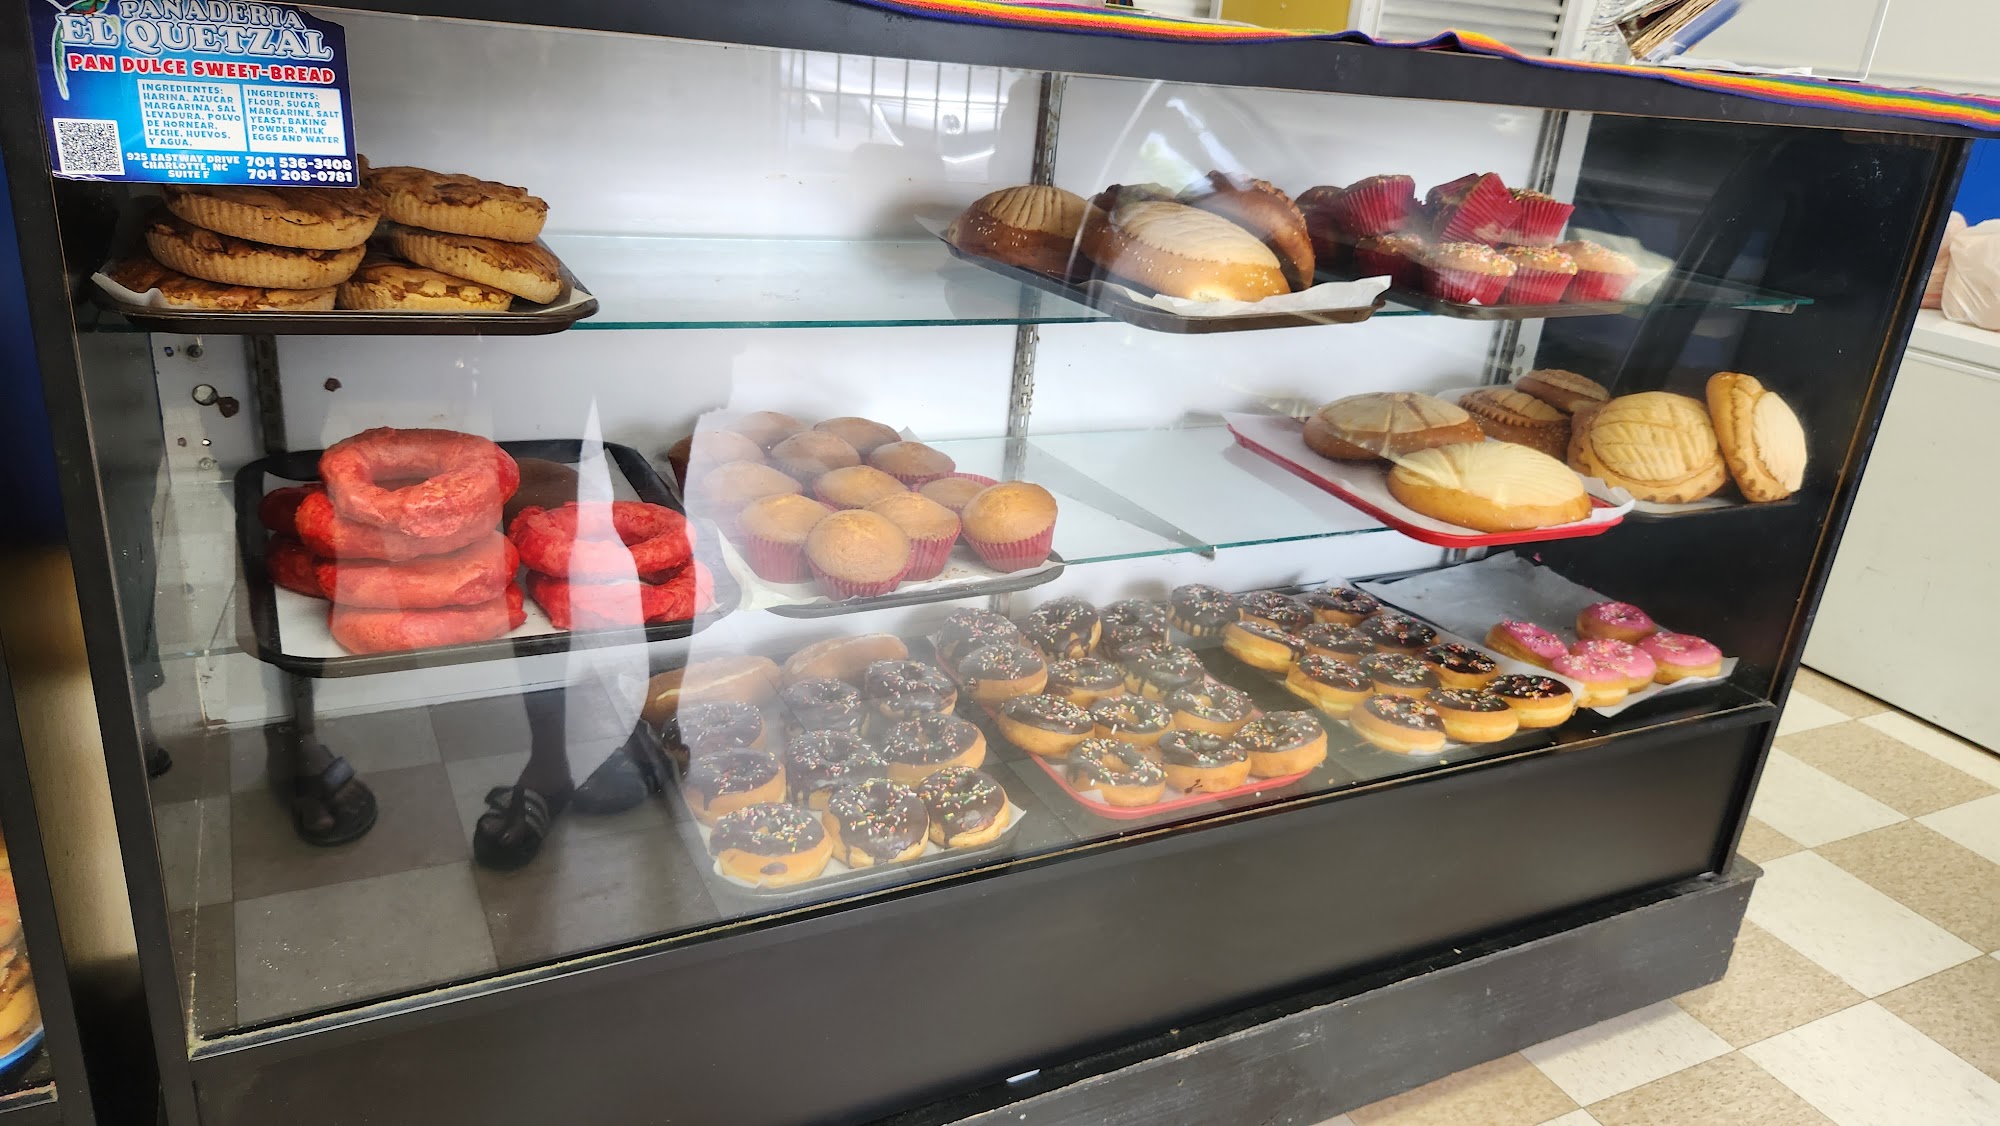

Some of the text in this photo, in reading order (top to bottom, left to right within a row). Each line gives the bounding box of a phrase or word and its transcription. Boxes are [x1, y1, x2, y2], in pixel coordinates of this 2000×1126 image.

[120, 0, 304, 30] PANADERIA
[61, 15, 332, 60] EL QUETZAL
[69, 54, 334, 82] PAN DULCE SWEET-BREAD
[142, 84, 223, 94] INGREDIENTES:
[193, 95, 233, 103] AZUCAR
[247, 89, 318, 100] INGREDIENTS:
[287, 100, 320, 108] SUGAR
[208, 113, 241, 121] POLVO
[288, 118, 327, 126] BAKING
[301, 127, 324, 135] MILK
[127, 152, 240, 164] 925 EASTWAY DRIVE
[245, 156, 352, 170] 704 536-3408
[213, 163, 228, 171] NC
[168, 170, 200, 178] SUITE
[247, 169, 352, 182] 704 208-0781
